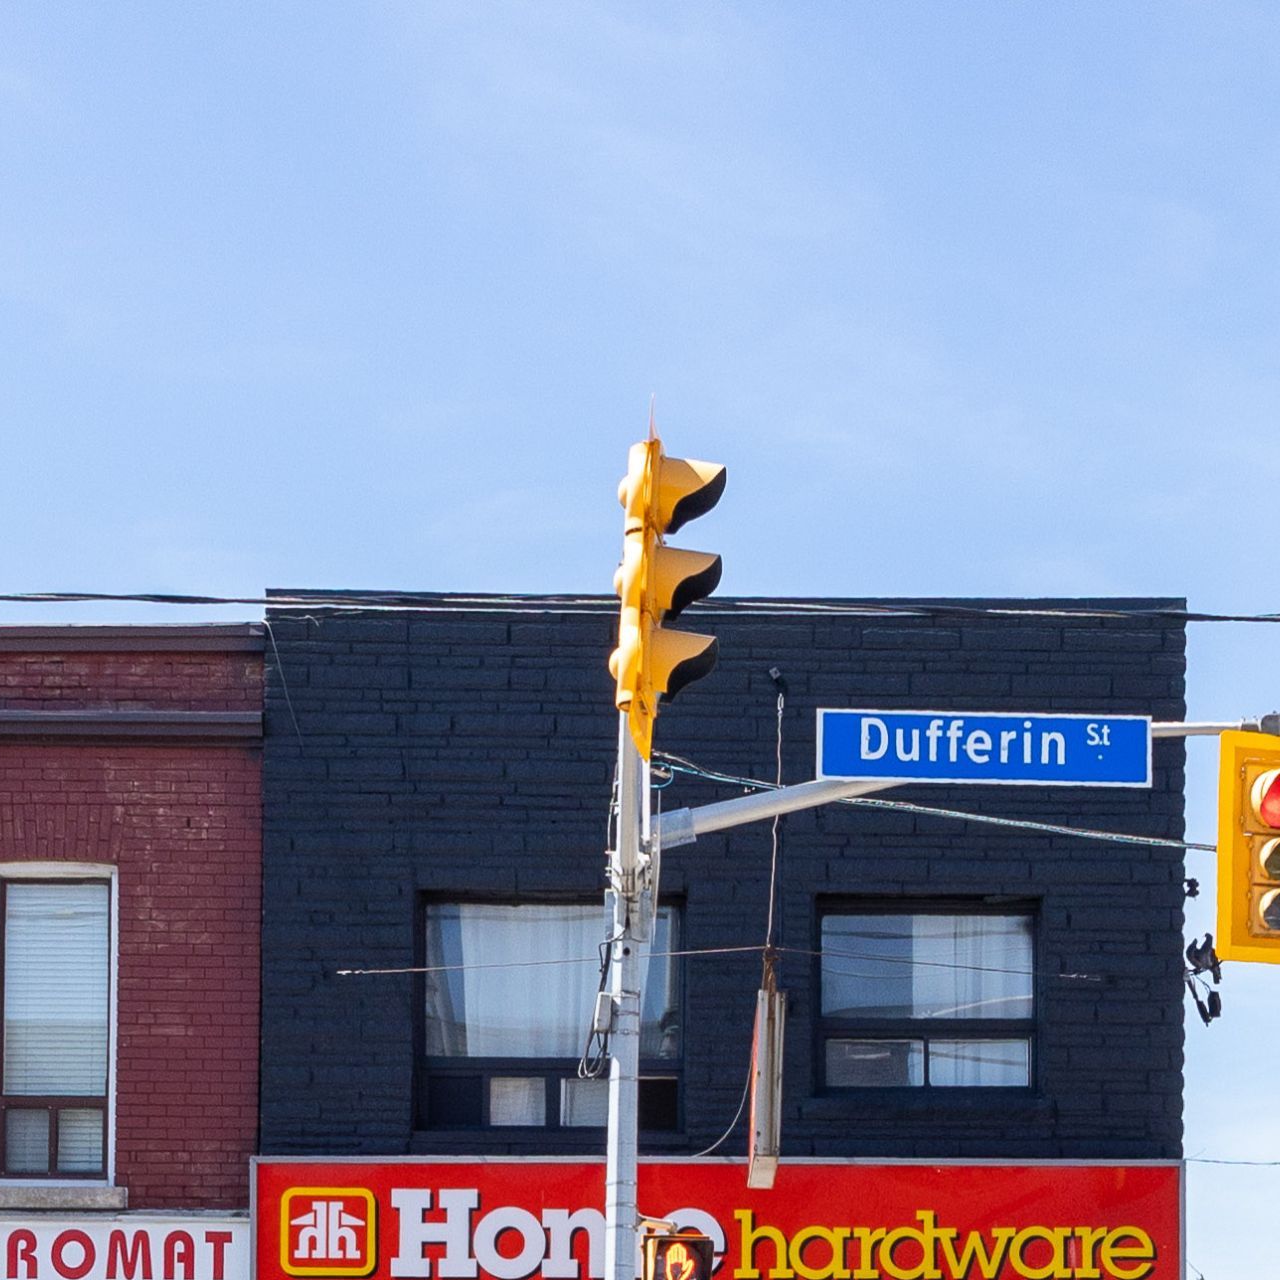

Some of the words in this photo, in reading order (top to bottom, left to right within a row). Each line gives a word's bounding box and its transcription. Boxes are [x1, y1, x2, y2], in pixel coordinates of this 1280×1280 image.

[860, 717, 1066, 765] Dufferin
[1086, 723, 1111, 746] St
[733, 1208, 1155, 1280] hardware
